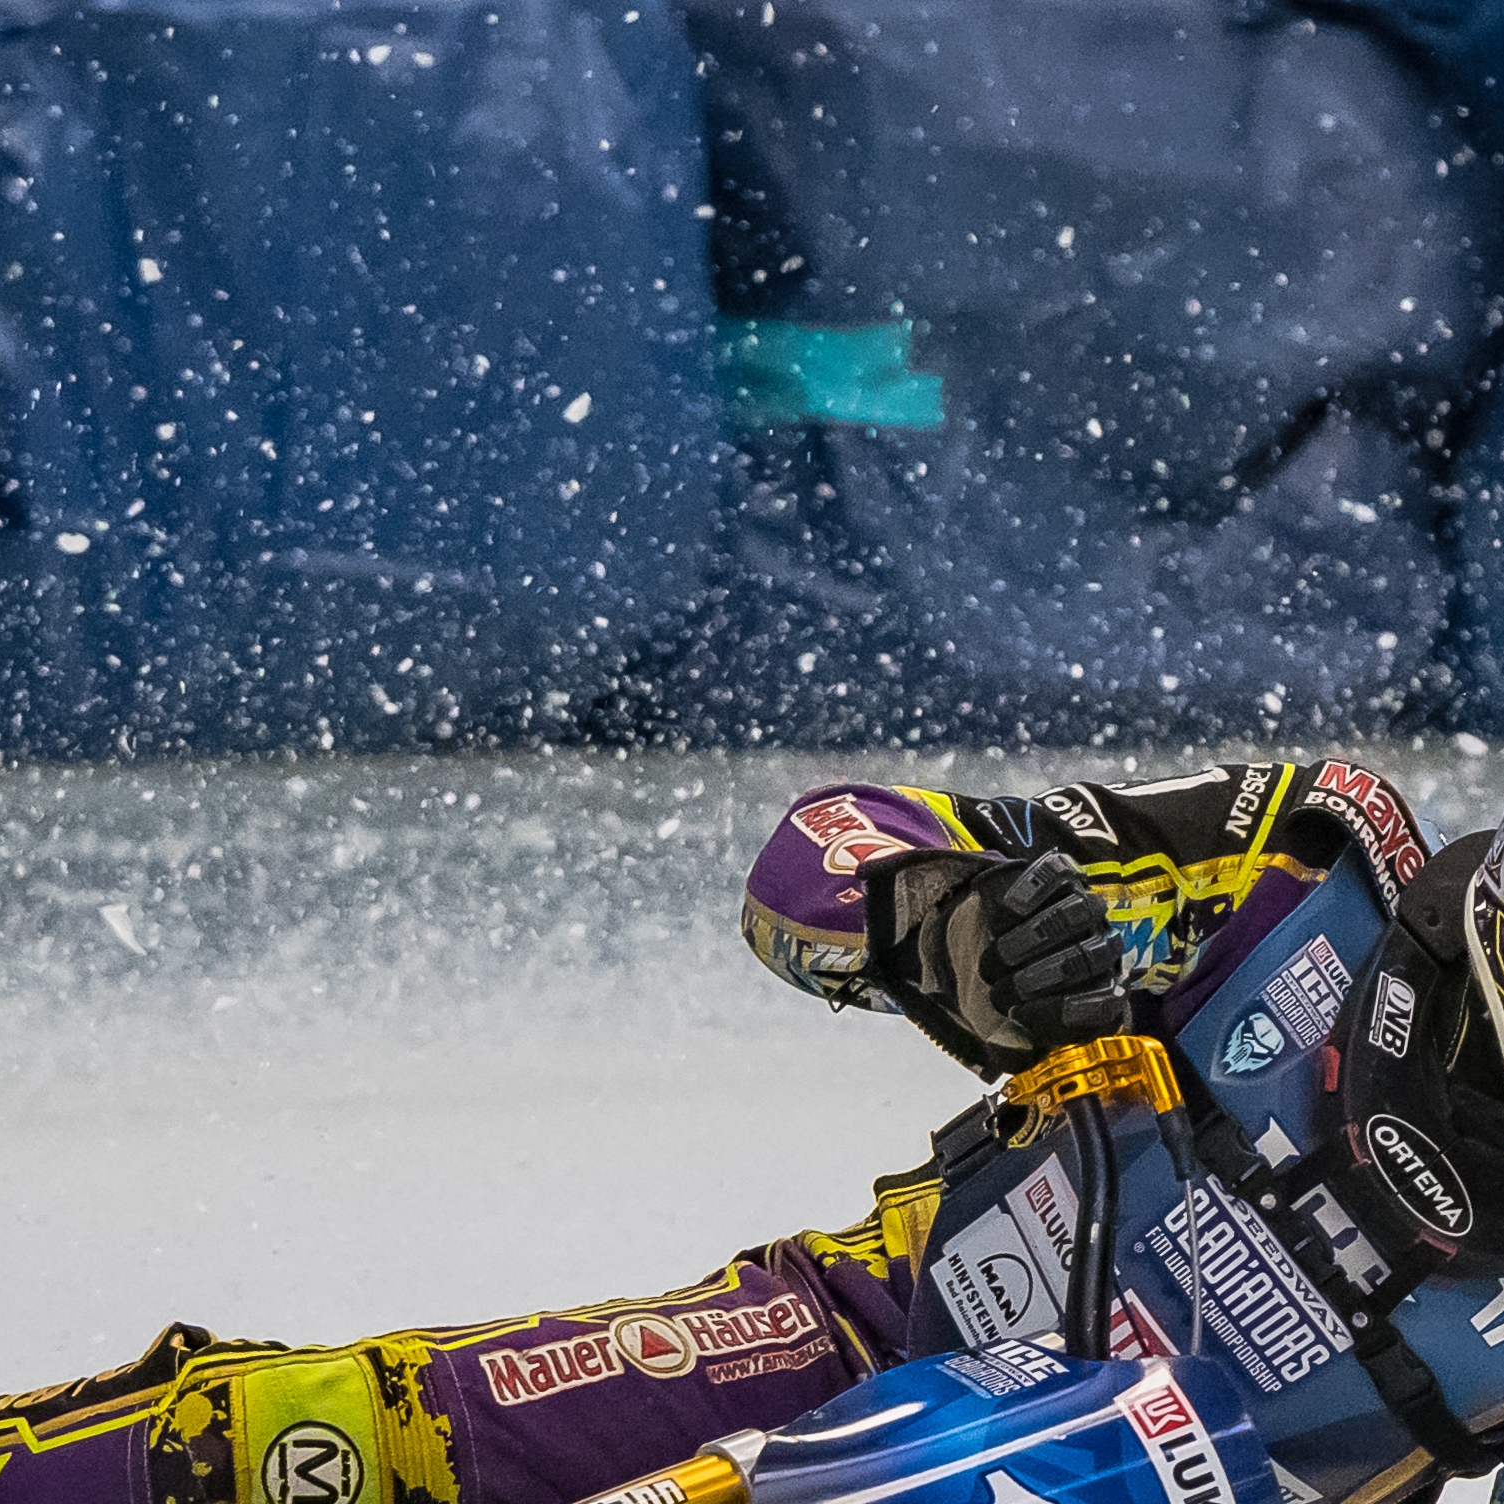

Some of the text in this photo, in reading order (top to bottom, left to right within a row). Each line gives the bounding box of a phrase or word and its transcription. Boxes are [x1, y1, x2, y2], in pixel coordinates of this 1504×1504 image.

[1374, 1126, 1461, 1228] ORTEMA
[980, 1263, 1017, 1325] MAN
[486, 1298, 811, 1402] Mauer Häuser
[984, 1340, 1070, 1381] ICE
